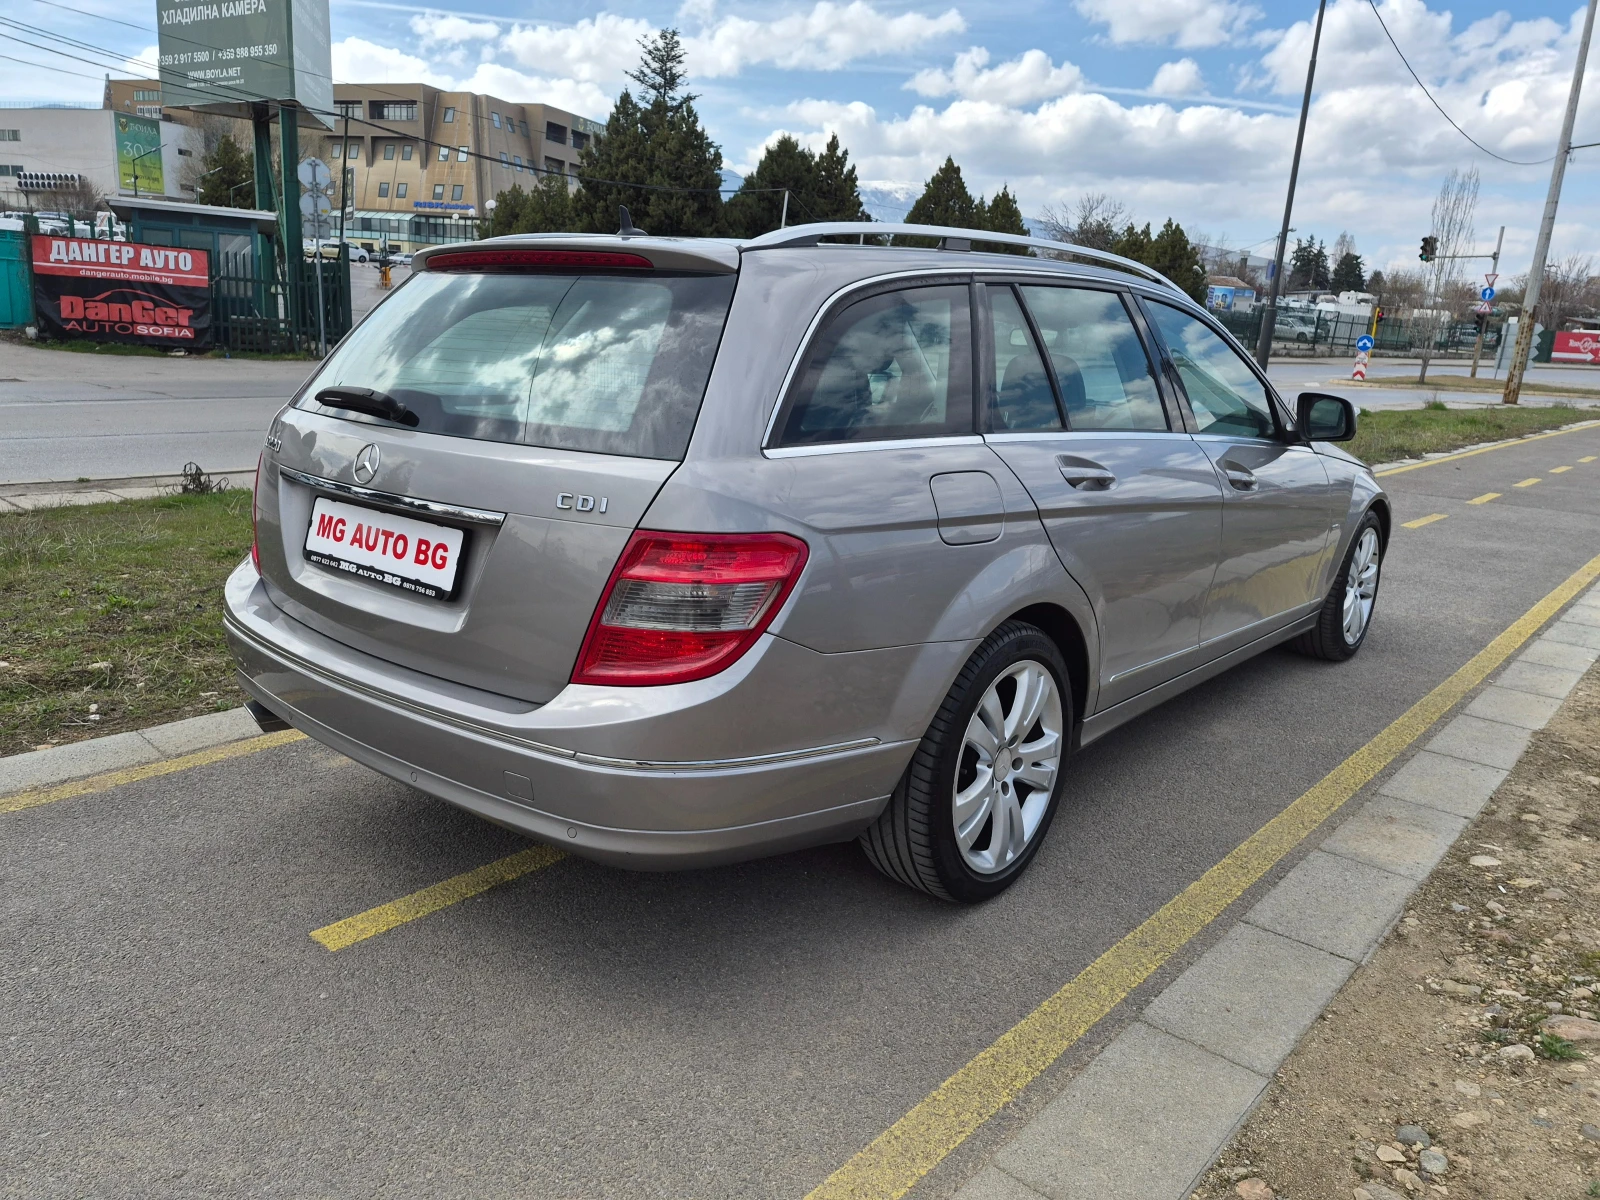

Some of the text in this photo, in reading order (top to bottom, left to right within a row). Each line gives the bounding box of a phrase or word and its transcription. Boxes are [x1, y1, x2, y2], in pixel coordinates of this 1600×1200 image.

[162, 0, 266, 25] ХЛАДИЛНА КАМЕРА
[173, 54, 179, 64] 2
[179, 52, 191, 64] 917
[193, 51, 209, 62] 5500
[218, 48, 234, 60] +359
[250, 45, 263, 57] 955
[264, 43, 277, 55] 350
[187, 67, 241, 79] WWW.BOYLA.NET
[123, 141, 143, 157] 30
[50, 240, 193, 271] ДАНГЕР АУТО
[79, 268, 173, 284] dangerauto.mobile.bg
[59, 295, 194, 327] DanGer
[63, 320, 192, 337] AUTO SOFIA
[556, 491, 608, 514] CDI
[316, 513, 449, 571] MG AUTO BG
[339, 560, 357, 573] MG
[357, 568, 383, 581] AUTO
[383, 573, 401, 586] BG
